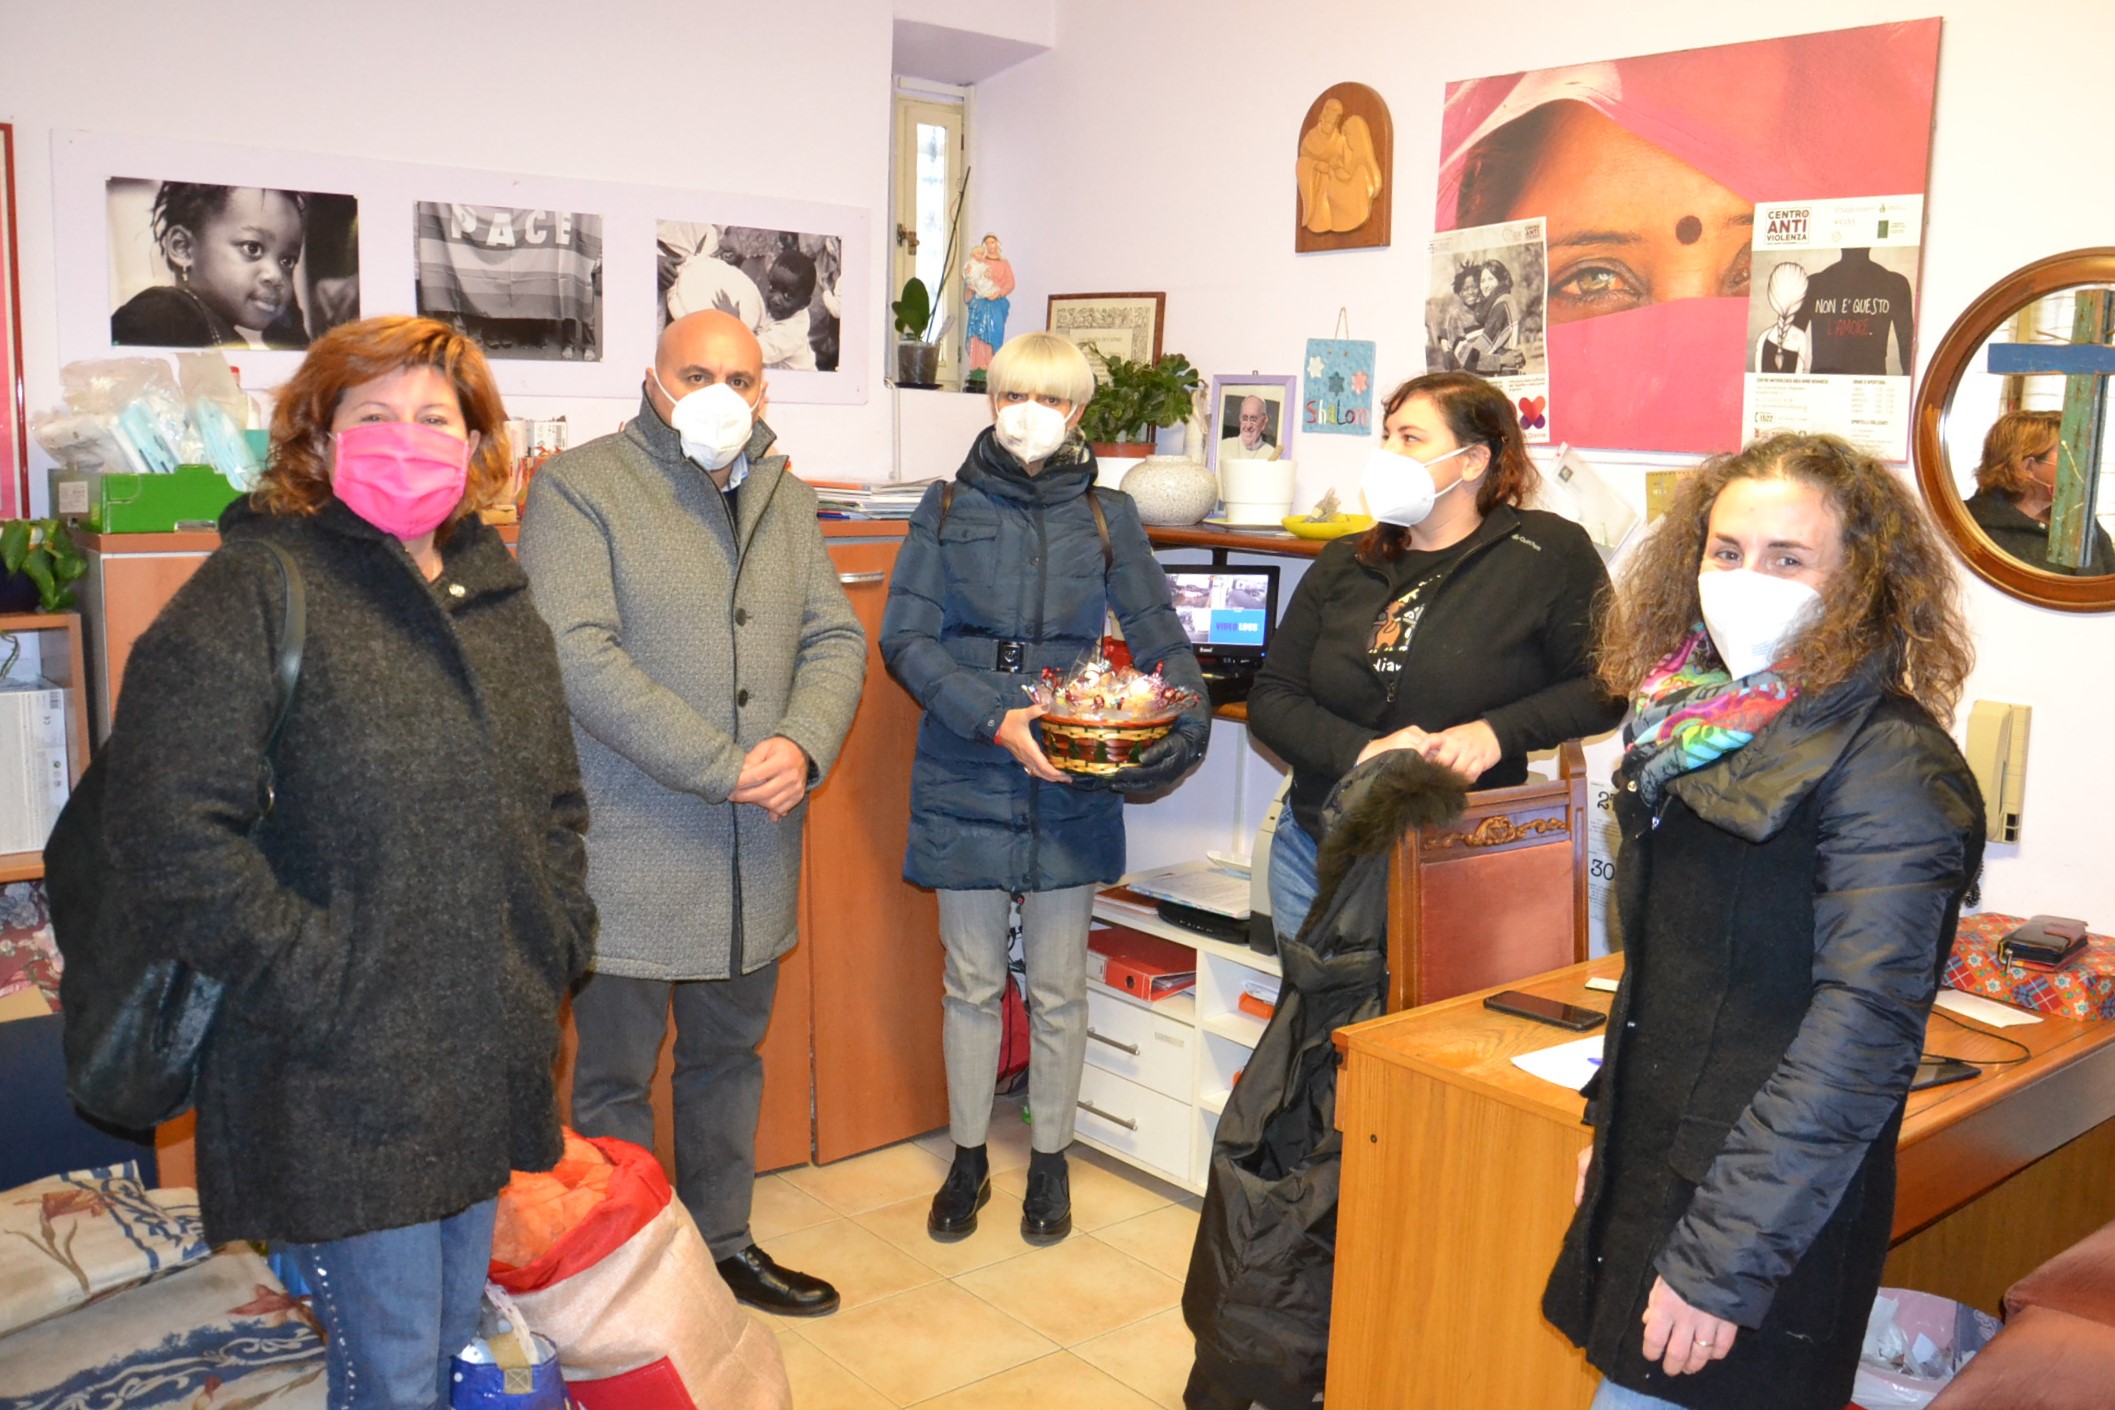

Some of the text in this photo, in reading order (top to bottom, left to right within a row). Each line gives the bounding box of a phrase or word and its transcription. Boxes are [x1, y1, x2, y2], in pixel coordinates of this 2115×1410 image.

[1768, 209, 1809, 219] CENTRO
[451, 203, 572, 247] PACE
[1767, 219, 1807, 234] ANTI
[1815, 298, 1836, 314] NON
[1852, 297, 1890, 315] QUESTO
[1306, 399, 1369, 425] Shalom
[1216, 622, 1238, 632] VIDEO
[1590, 858, 1615, 881] 30
